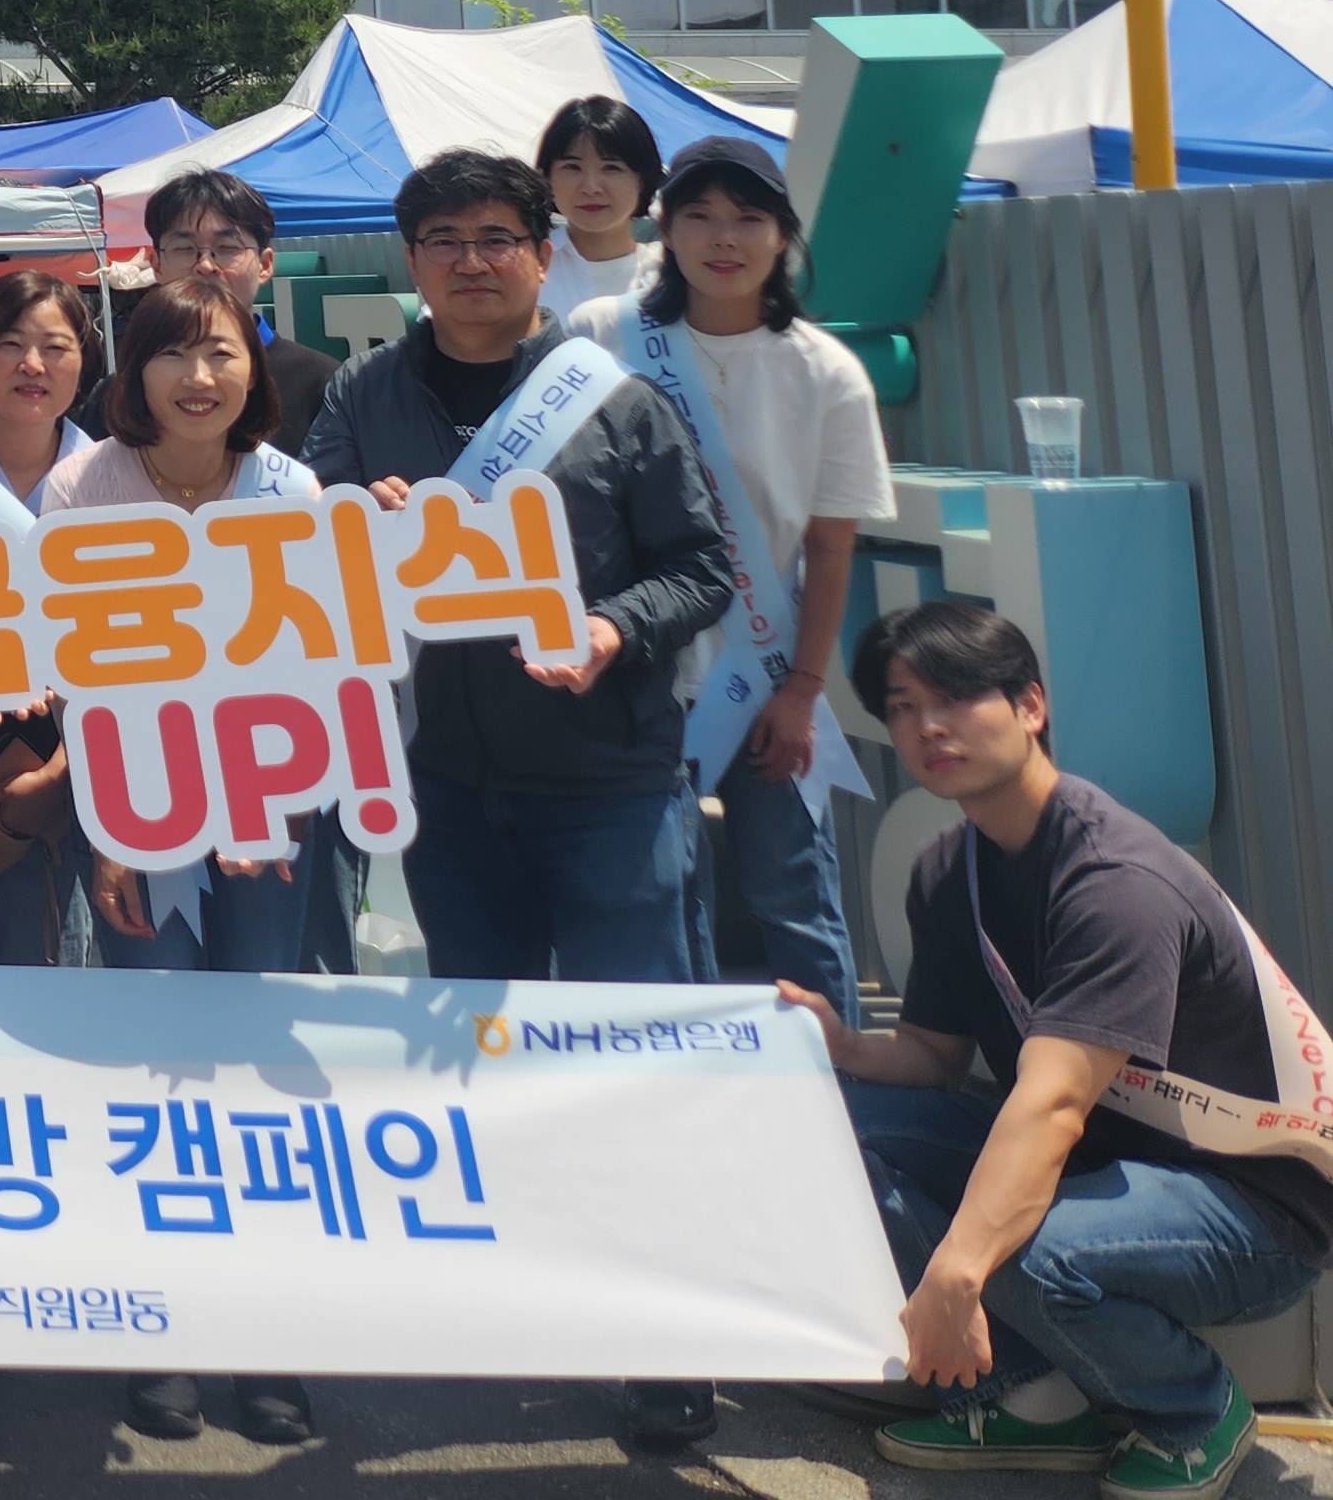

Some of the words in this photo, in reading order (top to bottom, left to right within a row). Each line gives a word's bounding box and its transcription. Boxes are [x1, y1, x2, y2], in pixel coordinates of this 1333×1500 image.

[81, 677, 398, 851] UP!
[518, 1018, 761, 1053] NH농협은행
[105, 1097, 498, 1242] 캠페인
